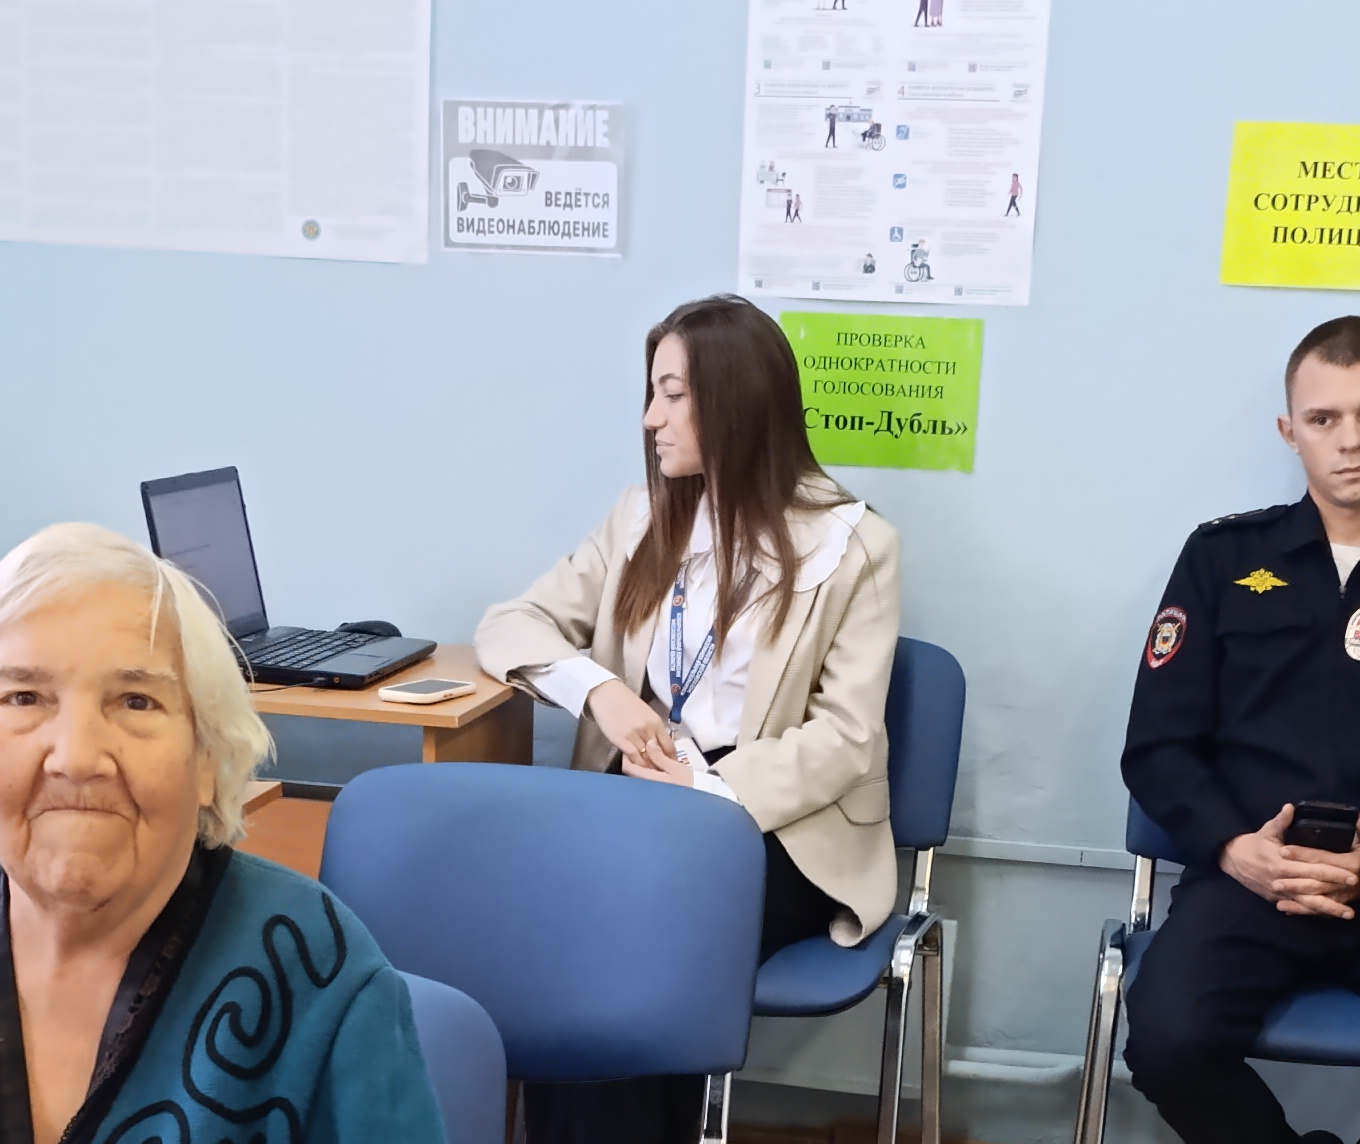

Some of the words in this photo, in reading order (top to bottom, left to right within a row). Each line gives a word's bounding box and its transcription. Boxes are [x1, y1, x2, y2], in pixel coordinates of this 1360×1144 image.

[457, 106, 610, 148] ВНИМАНИЕ
[545, 187, 610, 211] ВЕДЁТСЯ
[456, 216, 610, 240] ВИДЕОНАБЛЮДЕНИЕ
[836, 332, 927, 349] ПРОВЕРКА
[803, 355, 957, 375] ОДНОКРАТНОСТИ
[813, 380, 945, 399] ГОЛОСОВАНИЯ
